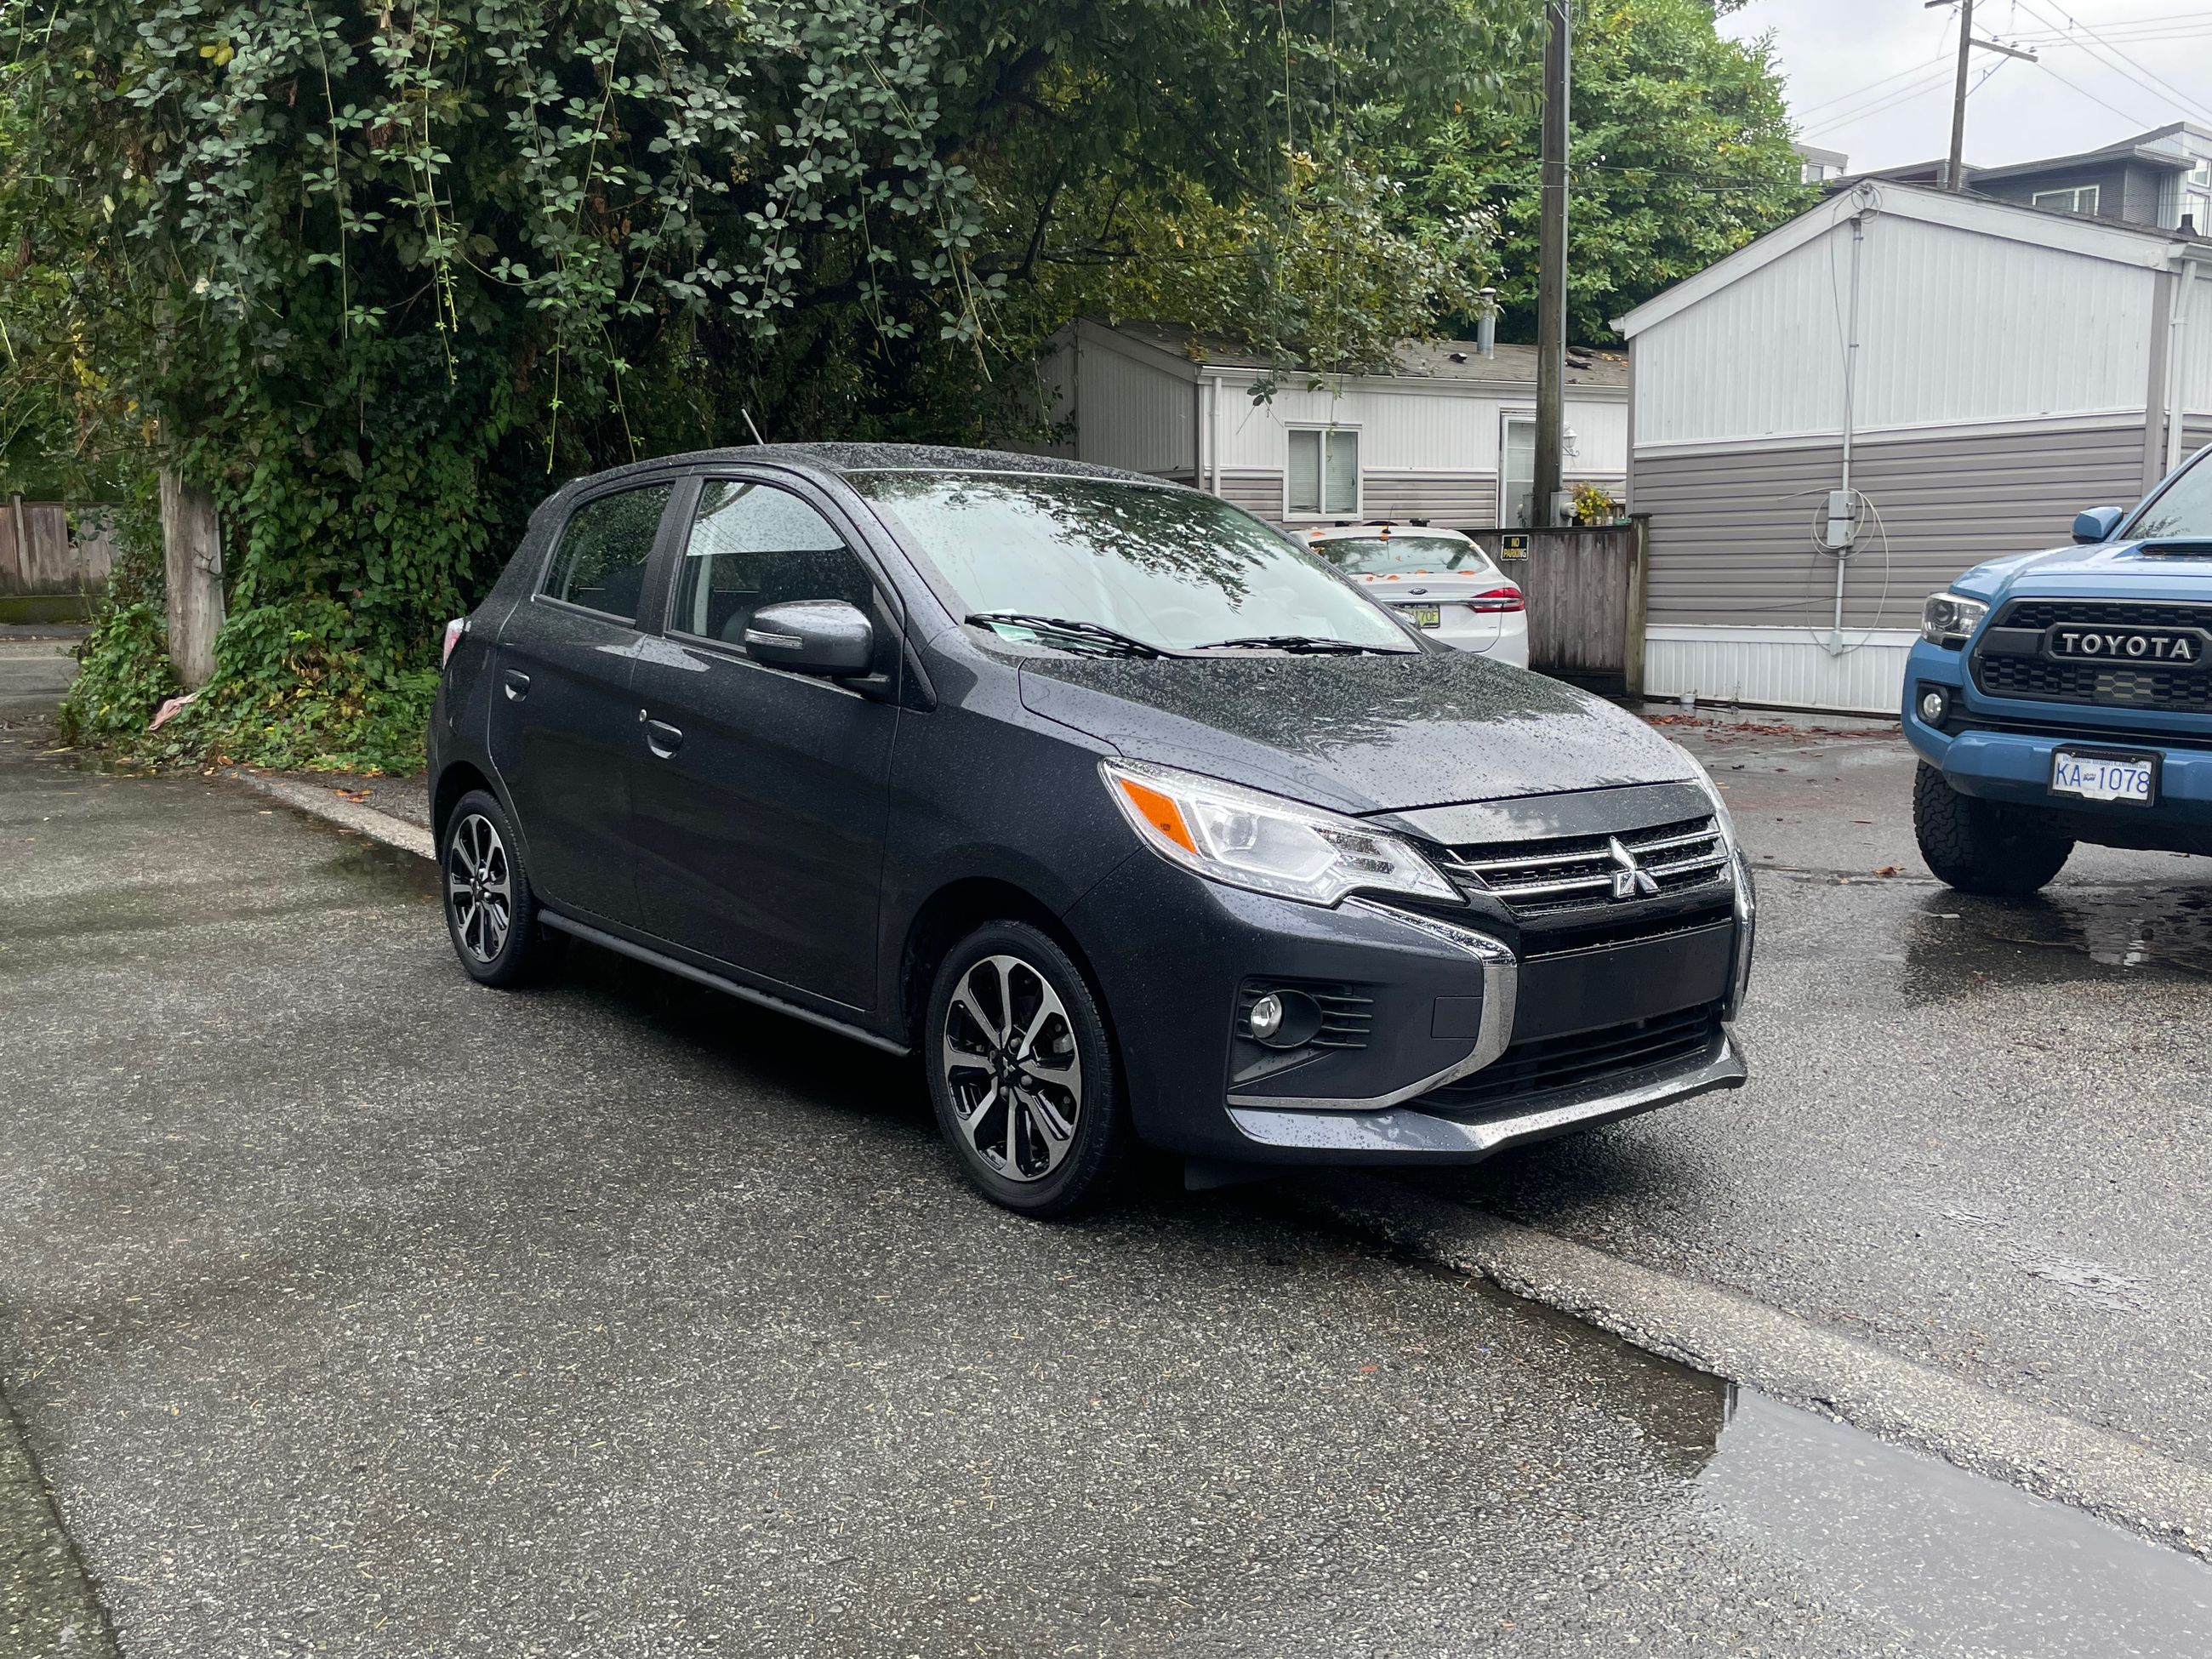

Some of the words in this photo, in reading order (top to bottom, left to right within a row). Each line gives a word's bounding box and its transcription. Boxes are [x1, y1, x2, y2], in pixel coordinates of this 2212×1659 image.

[1511, 537, 1520, 547] NO
[1503, 548, 1527, 558] PARKING
[2062, 633, 2191, 659] TOYOTA
[2056, 762, 2081, 788] KA
[2100, 767, 2151, 793] 1078
